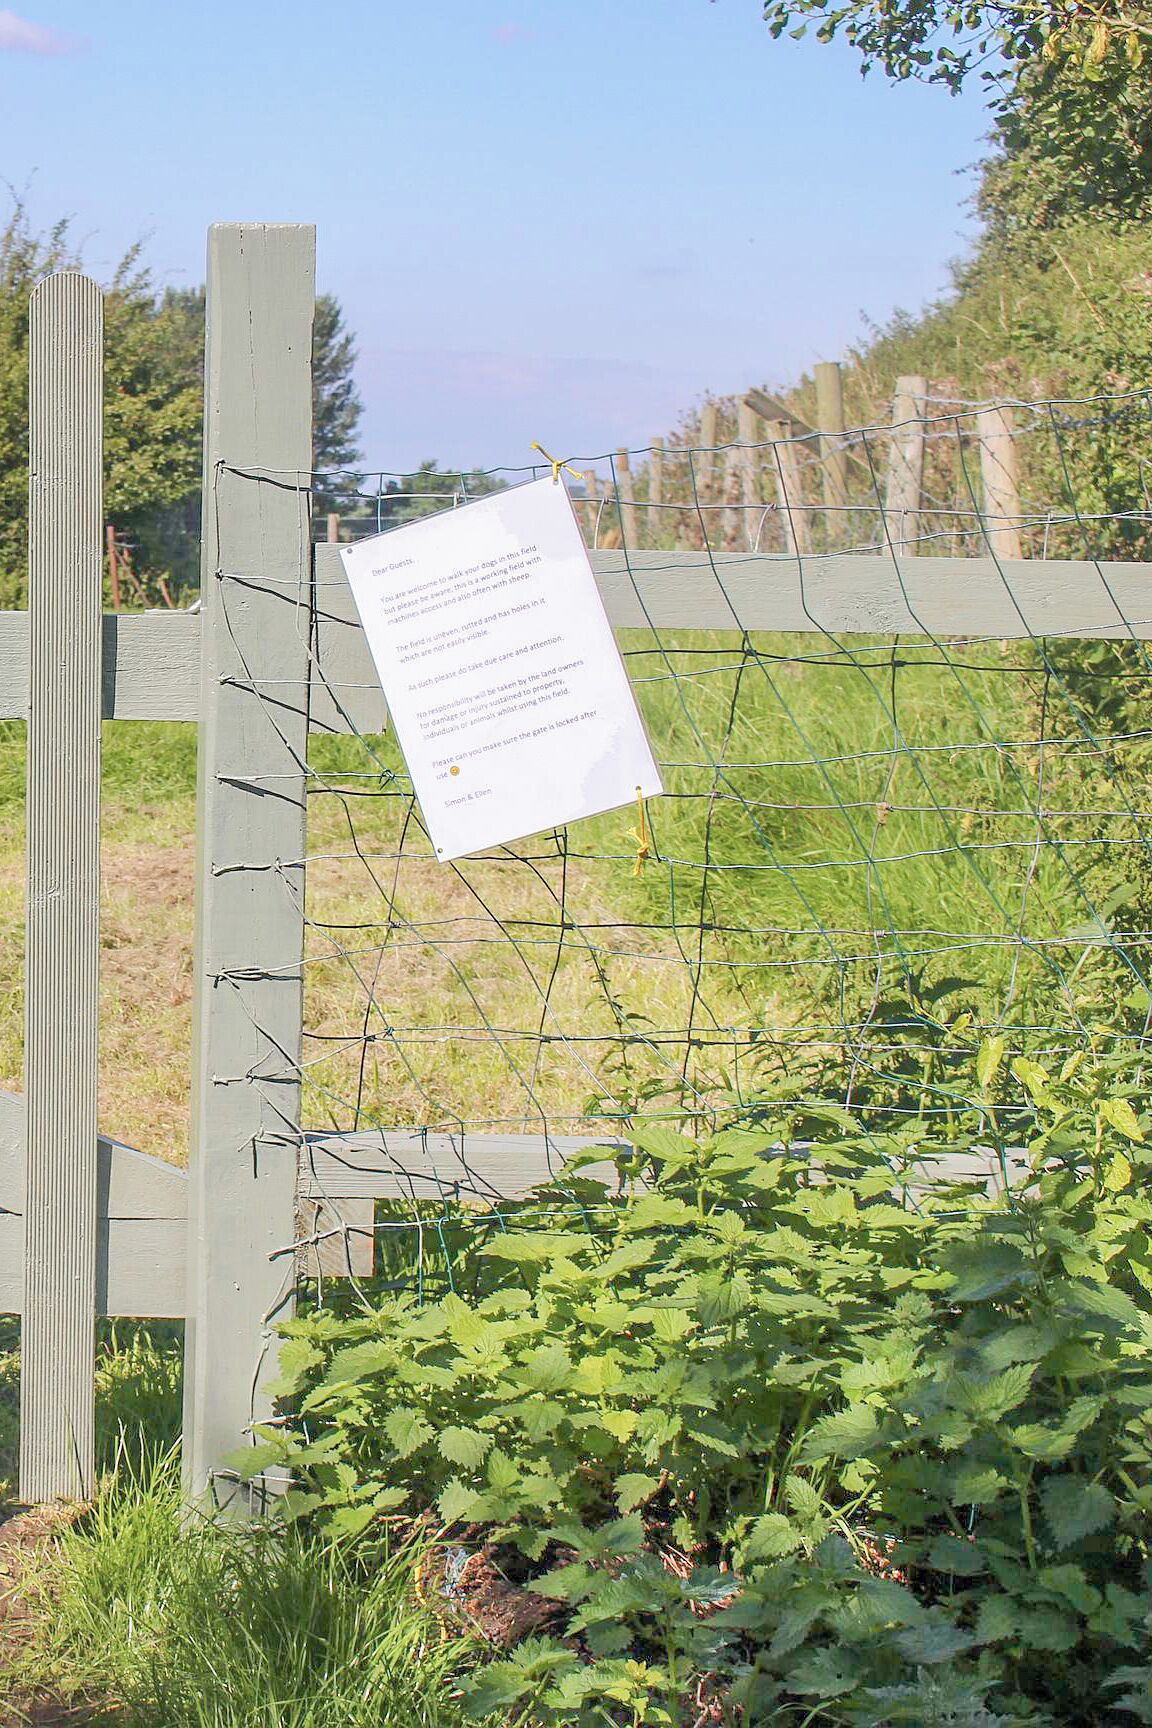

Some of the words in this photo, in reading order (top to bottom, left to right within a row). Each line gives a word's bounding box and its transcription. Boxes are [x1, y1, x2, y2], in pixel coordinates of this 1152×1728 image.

[372, 568, 389, 576] Dear
[381, 595, 394, 603] You
[408, 580, 438, 594] welcome
[448, 570, 463, 580] walk
[465, 566, 480, 576] your
[481, 560, 498, 569] dogs
[507, 552, 520, 560] this
[521, 545, 537, 555] field
[384, 606, 396, 614] but
[398, 599, 420, 611] please
[454, 582, 467, 590] this
[481, 568, 509, 581] working
[509, 562, 525, 571] field
[526, 556, 542, 566] with
[388, 611, 420, 625] machines
[421, 603, 442, 614] access
[443, 597, 457, 606] and
[457, 593, 471, 601] also
[473, 586, 491, 596] often
[493, 580, 508, 589] with
[410, 638, 426, 648] field
[462, 618, 483, 630] rutted
[484, 613, 498, 623] and
[498, 610, 511, 618] has
[512, 604, 531, 613] holes
[400, 652, 420, 663] which
[434, 643, 446, 652] not
[447, 638, 466, 648] easily
[418, 678, 434, 688] such
[435, 671, 457, 684] please
[468, 662, 484, 671] take
[499, 652, 514, 661] care
[515, 646, 529, 655] and
[530, 636, 565, 650] attention.
[428, 697, 473, 715] responsibility
[473, 691, 487, 700] will
[497, 682, 517, 692] taken
[542, 668, 557, 677] land
[558, 660, 584, 672] owners
[431, 713, 459, 726] damage
[468, 704, 489, 713] injury
[489, 691, 522, 707] sustained
[470, 713, 496, 725] animals
[497, 705, 518, 716] whilst
[519, 700, 538, 709] using
[432, 757, 455, 768] Please
[468, 748, 483, 758] you
[483, 742, 502, 751] make
[503, 737, 518, 745] sure
[519, 732, 531, 740] the
[533, 727, 548, 737] gate
[556, 716, 579, 728] locked
[580, 711, 598, 720] after
[445, 797, 466, 807] Simon
